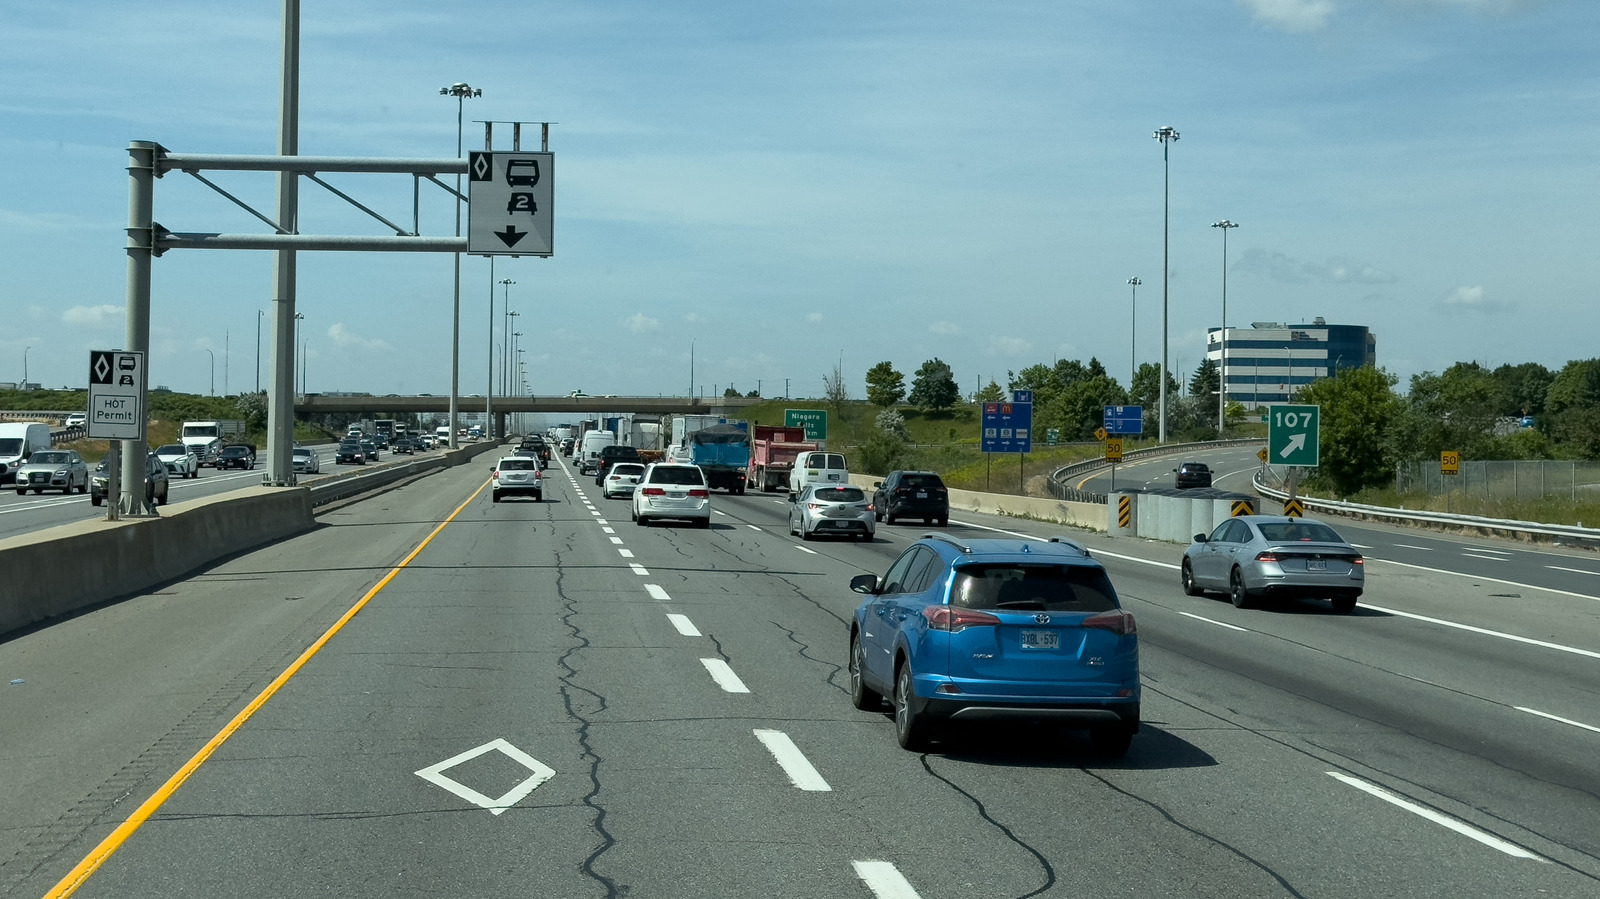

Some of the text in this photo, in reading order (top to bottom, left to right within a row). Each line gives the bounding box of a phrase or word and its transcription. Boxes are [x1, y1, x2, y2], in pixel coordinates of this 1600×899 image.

[515, 195, 529, 209] 2
[123, 375, 131, 384] 2
[104, 399, 126, 409] HOT
[97, 410, 132, 420] Permit
[791, 413, 820, 421] Niagara
[1276, 412, 1313, 428] 107
[1107, 443, 1121, 453] 50
[1442, 455, 1456, 465] 50
[1044, 633, 1059, 645] 537
